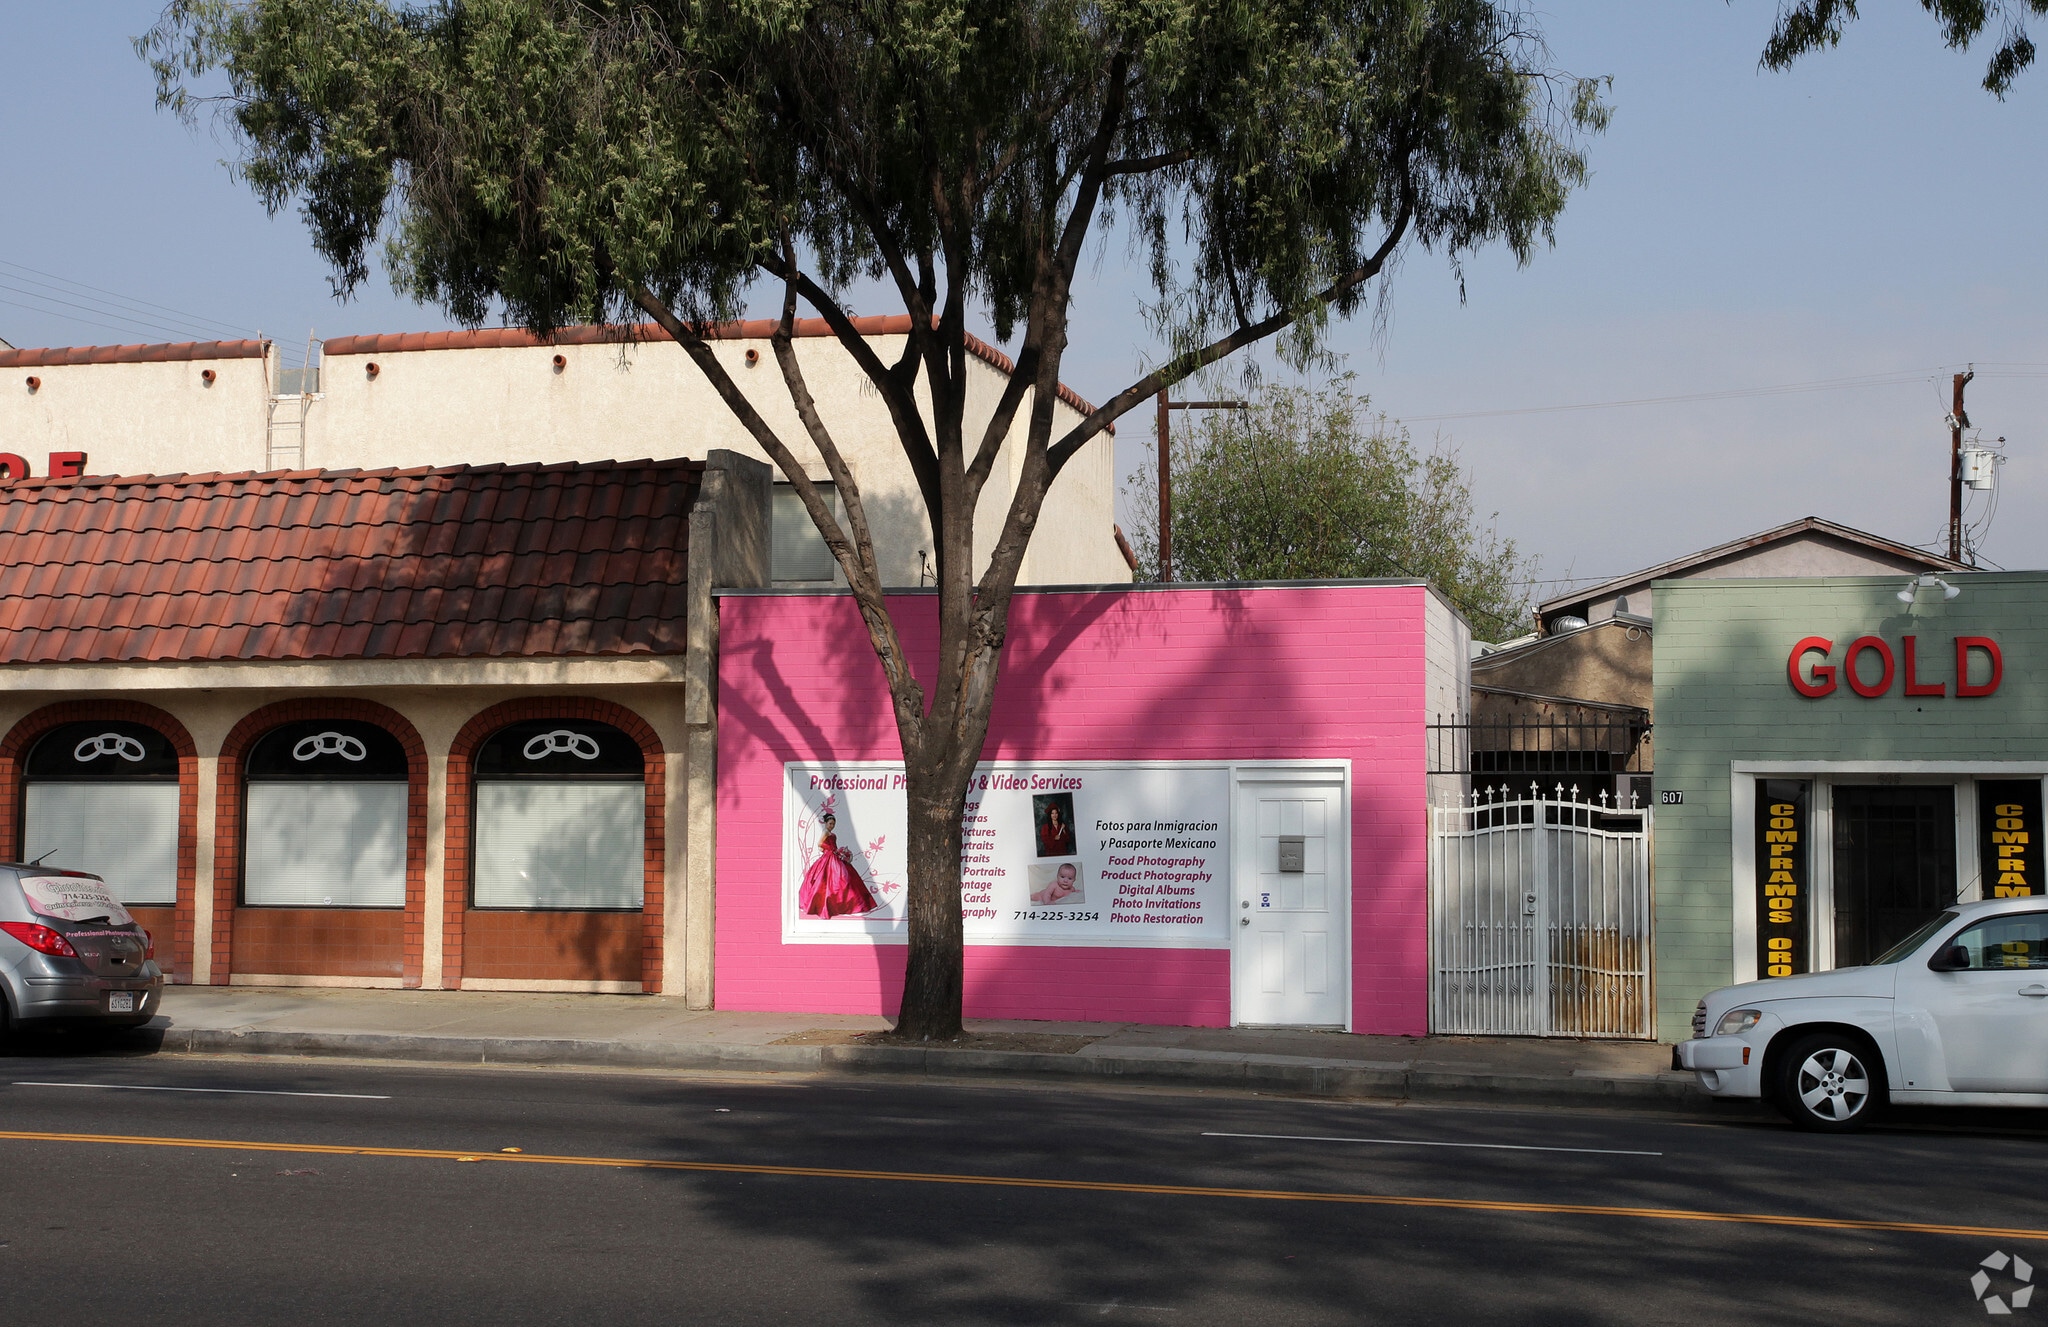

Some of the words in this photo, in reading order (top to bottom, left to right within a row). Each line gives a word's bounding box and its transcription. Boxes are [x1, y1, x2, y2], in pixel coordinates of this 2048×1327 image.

[1788, 635, 2003, 698] GOLD
[809, 774, 888, 790] Professional
[978, 774, 989, 790] &
[991, 774, 1029, 790] Video
[1030, 773, 1083, 790] Services
[1662, 791, 1683, 804] 607
[1095, 819, 1125, 831] Fotos
[1126, 822, 1152, 833] para
[1153, 819, 1218, 834] Inmigracion
[1099, 840, 1107, 851] y
[1108, 837, 1163, 851] Pasaporte
[1164, 837, 1217, 849] Mexicano
[1991, 804, 2031, 898] COMPRAM
[960, 853, 990, 863] rtraits
[1108, 855, 1135, 866] Food
[1136, 855, 1206, 868] Photography
[1764, 803, 1798, 924] COMPRAMOS
[963, 866, 1006, 877] Portraits
[1101, 869, 1142, 880] Product
[1143, 870, 1212, 883] Photography
[960, 880, 992, 891] ontage
[1118, 884, 1154, 897] Digital
[1155, 884, 1196, 896] Albums
[963, 893, 991, 903] Cards
[1112, 898, 1143, 909] Photo
[1144, 898, 1202, 910] Invitations
[961, 907, 997, 919] graphy
[1013, 911, 1099, 921] 714-225-3254
[1110, 912, 1141, 923] Photo
[1142, 913, 1204, 924] Restoration
[65, 930, 105, 938] Professional
[1767, 937, 1793, 977] ORO
